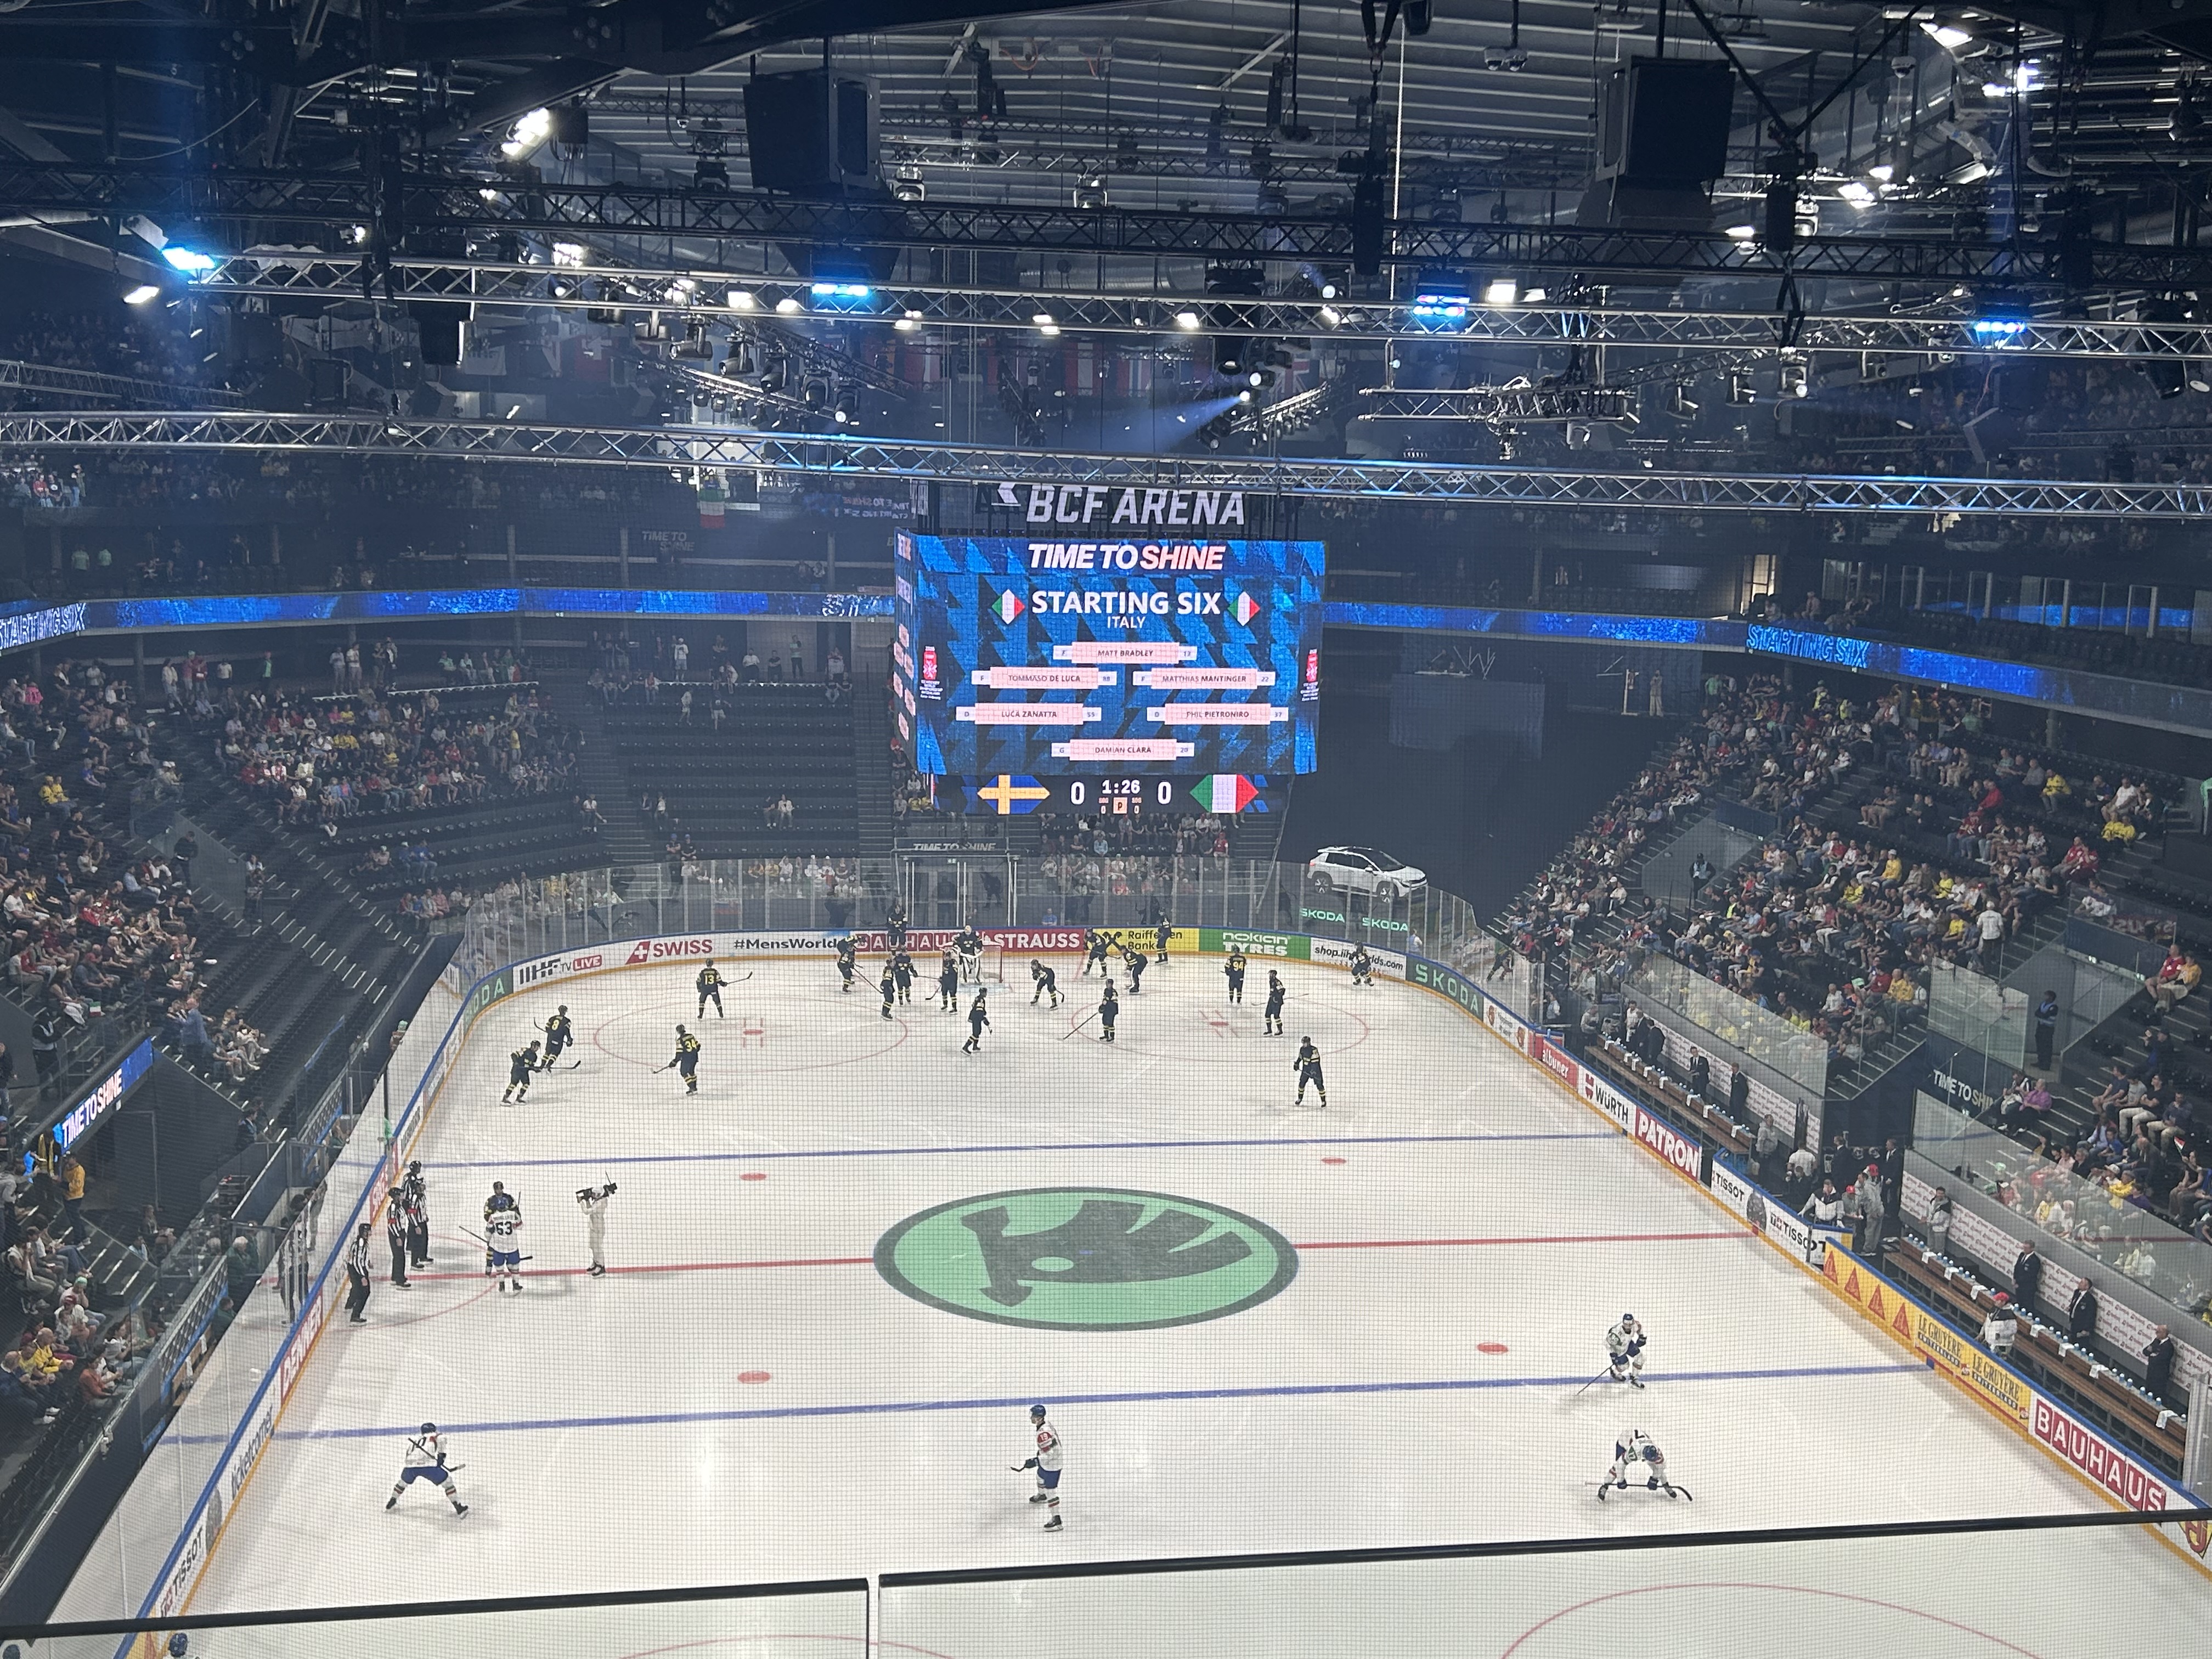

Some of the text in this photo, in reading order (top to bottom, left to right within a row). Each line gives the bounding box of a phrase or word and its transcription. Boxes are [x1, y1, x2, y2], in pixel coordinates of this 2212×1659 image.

[1026, 485, 1245, 525] BCF ARENA
[671, 531, 687, 541] TO
[1029, 544, 1226, 570] TIME TO SHINE
[1032, 591, 1221, 614] STARTING SIX
[1108, 616, 1146, 629] ITALY
[1070, 779, 1172, 805] 0 1:26 0
[734, 938, 838, 950] #MensWorld
[994, 933, 1080, 949] STRAUSS
[1128, 930, 1182, 939] Raiffeen
[653, 939, 713, 958] SWISS
[1128, 940, 1155, 950] Bank
[1223, 942, 1288, 956] TYRES
[574, 956, 601, 969] LIVE
[1233, 961, 1244, 971] 94
[704, 974, 715, 985] 13
[552, 1019, 559, 1030] 8
[685, 1039, 697, 1052] 34
[1933, 1069, 1994, 1111] TIME TO SHI
[62, 1068, 123, 1148] TIME TO SHINE
[1595, 1085, 1629, 1124] WÜRTH
[1638, 1110, 1699, 1177] PATRON
[1716, 1172, 1745, 1202] TISSOT
[1918, 1314, 1927, 1334] LE
[1972, 1353, 1983, 1373] LE
[2037, 1404, 2164, 1511] BAUHAUS
[173, 1526, 203, 1596] TISSOT
